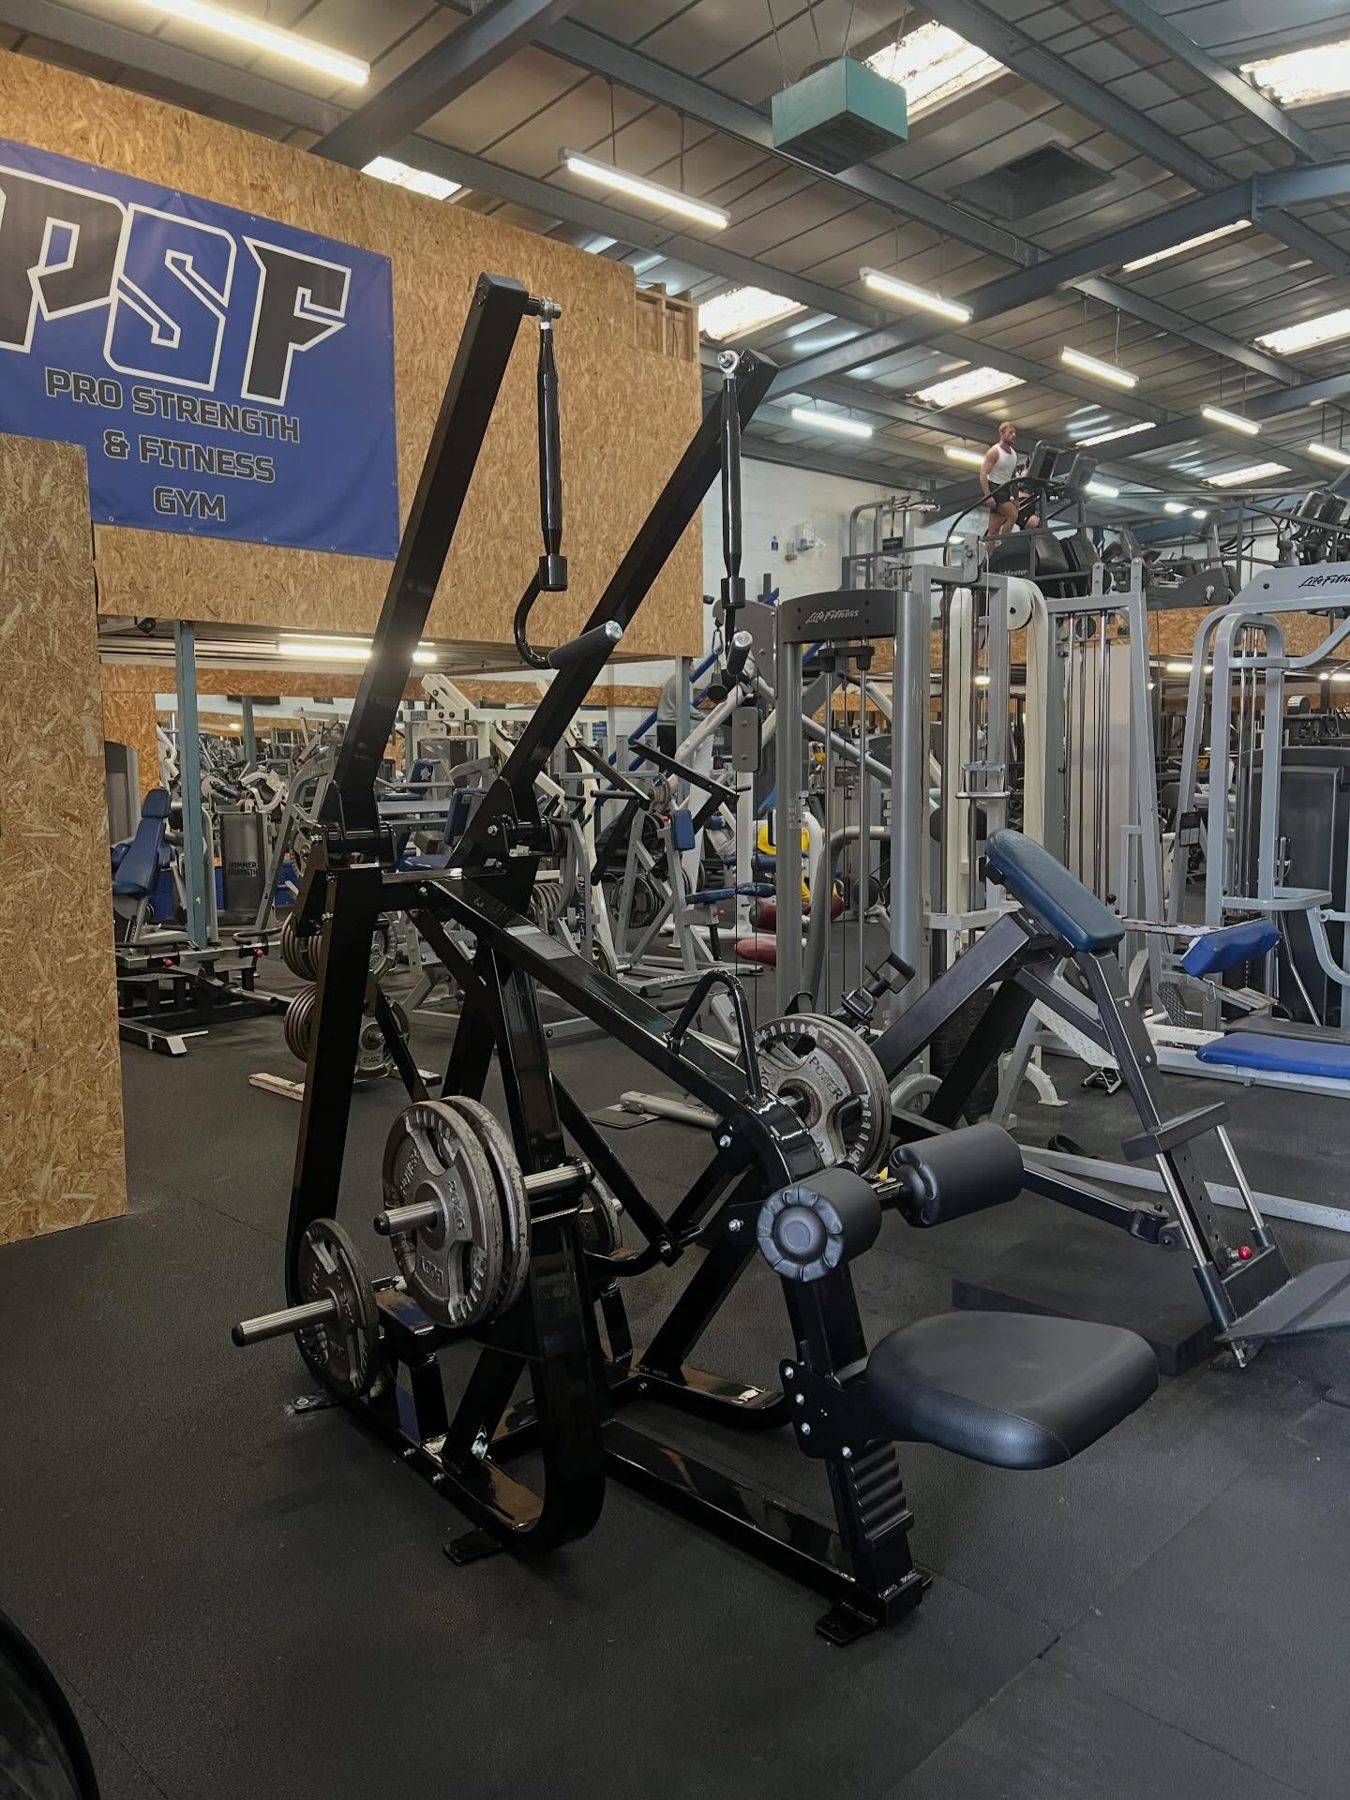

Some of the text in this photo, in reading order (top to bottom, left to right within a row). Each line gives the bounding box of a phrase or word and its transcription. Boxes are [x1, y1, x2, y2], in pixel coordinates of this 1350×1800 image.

[0, 165, 352, 406] PSF
[45, 367, 301, 443] PRO STRENGTH
[103, 429, 276, 483] & FITNESS
[153, 487, 226, 522] GYM
[808, 1055, 845, 1101] POWER
